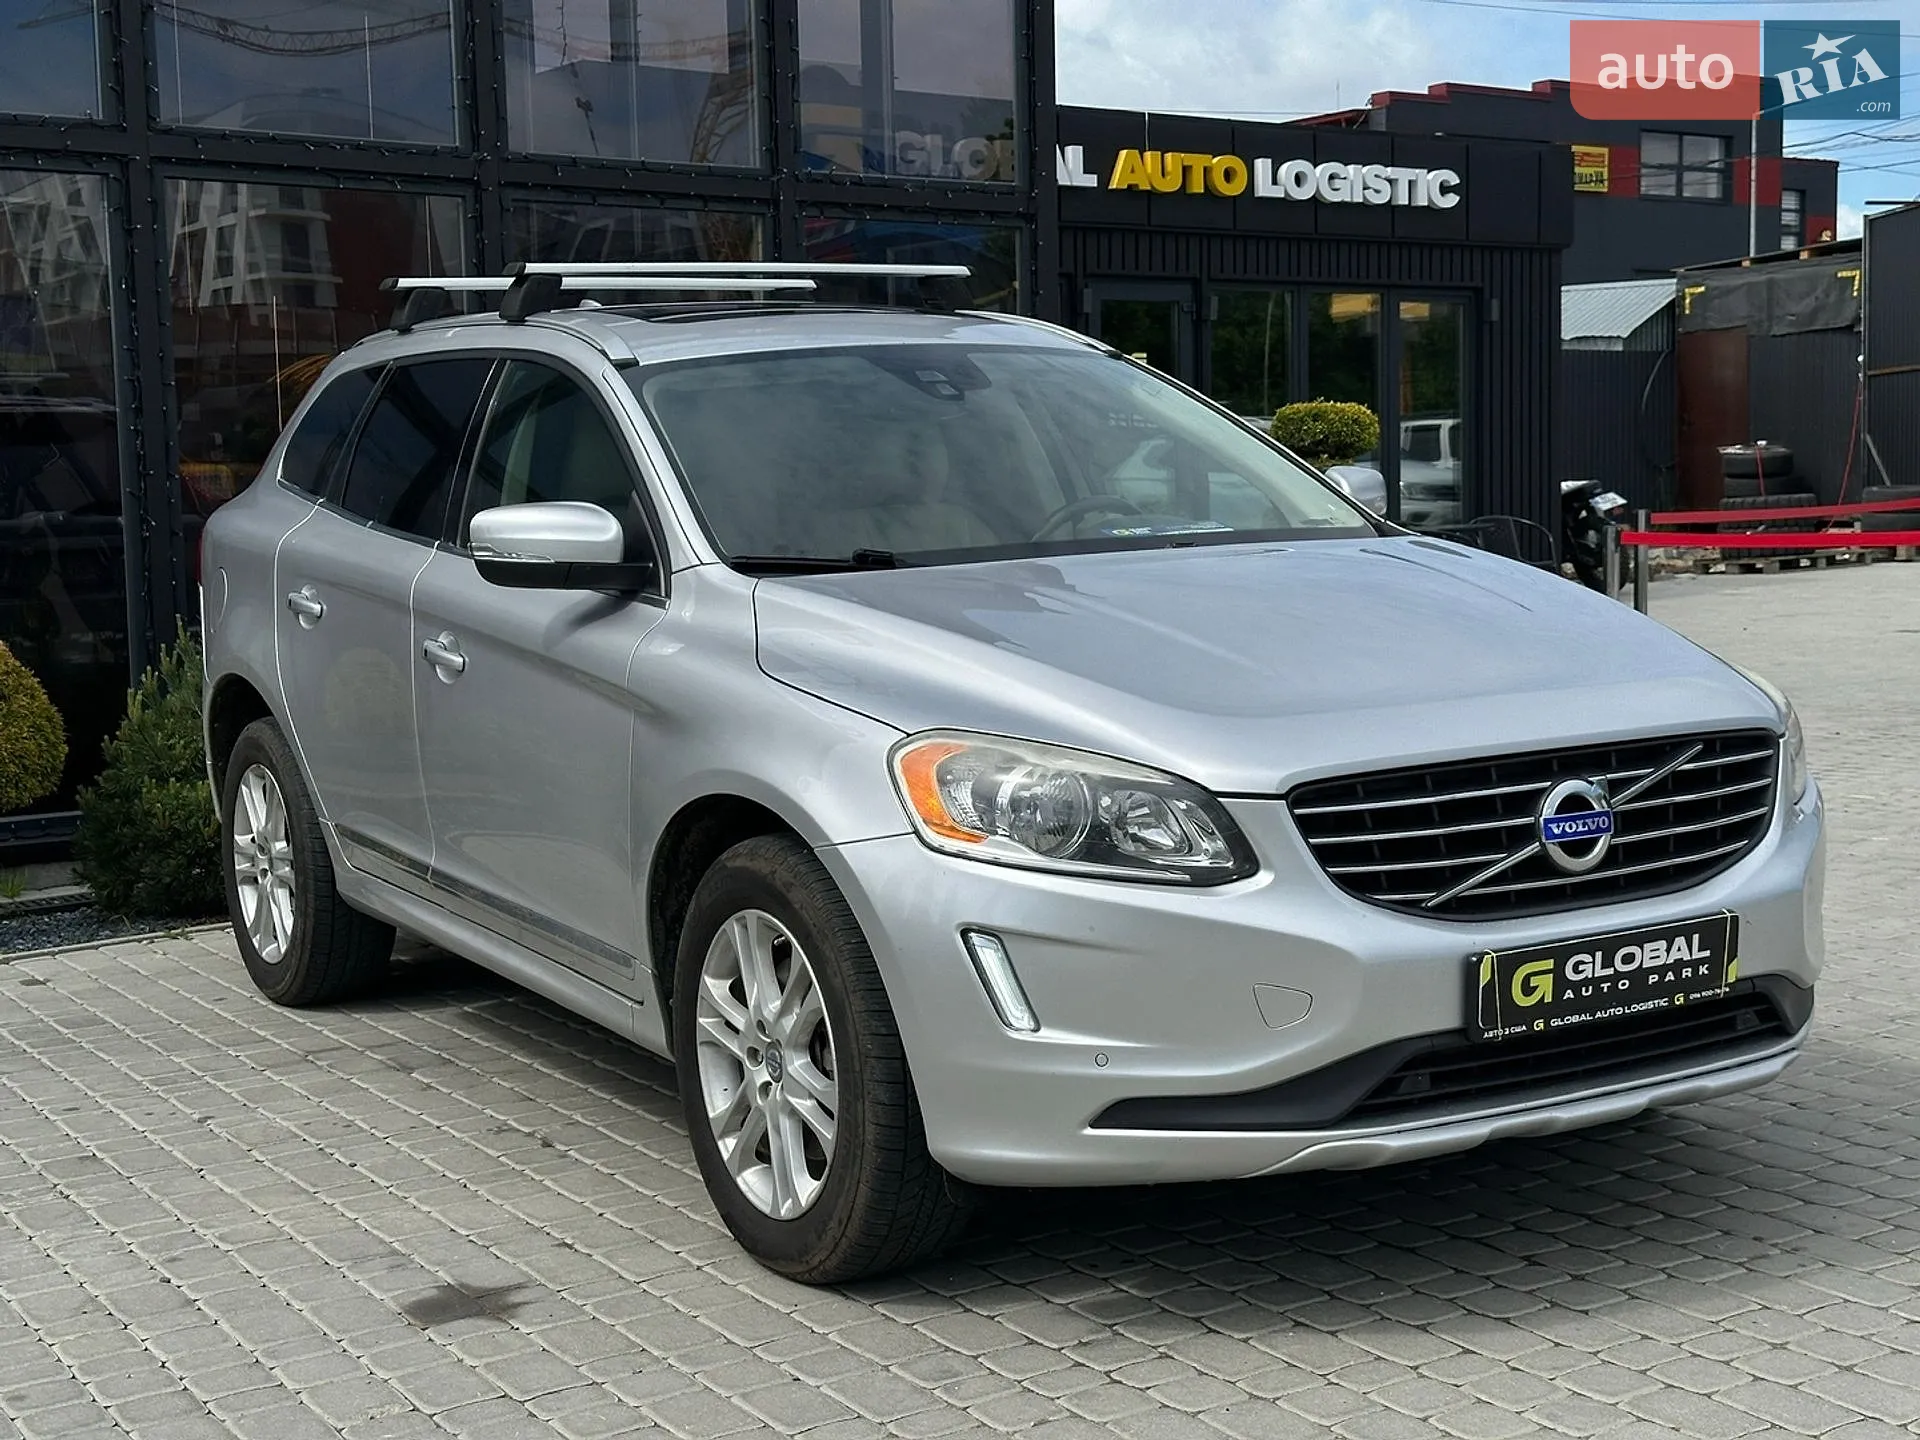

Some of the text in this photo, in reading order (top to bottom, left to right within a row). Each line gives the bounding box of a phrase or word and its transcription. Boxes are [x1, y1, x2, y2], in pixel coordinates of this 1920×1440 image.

[1108, 149, 1248, 197] AUTO
[1253, 158, 1461, 209] LOGISTIC
[1548, 816, 1609, 835] VOLVO
[1565, 933, 1711, 982] GLOBAL
[1562, 963, 1710, 1000] AUTO PARK
[1550, 1012, 1593, 1027] GLOBAL
[1594, 1006, 1624, 1019] AUTO
[1624, 997, 1669, 1014] LOGISTIC
